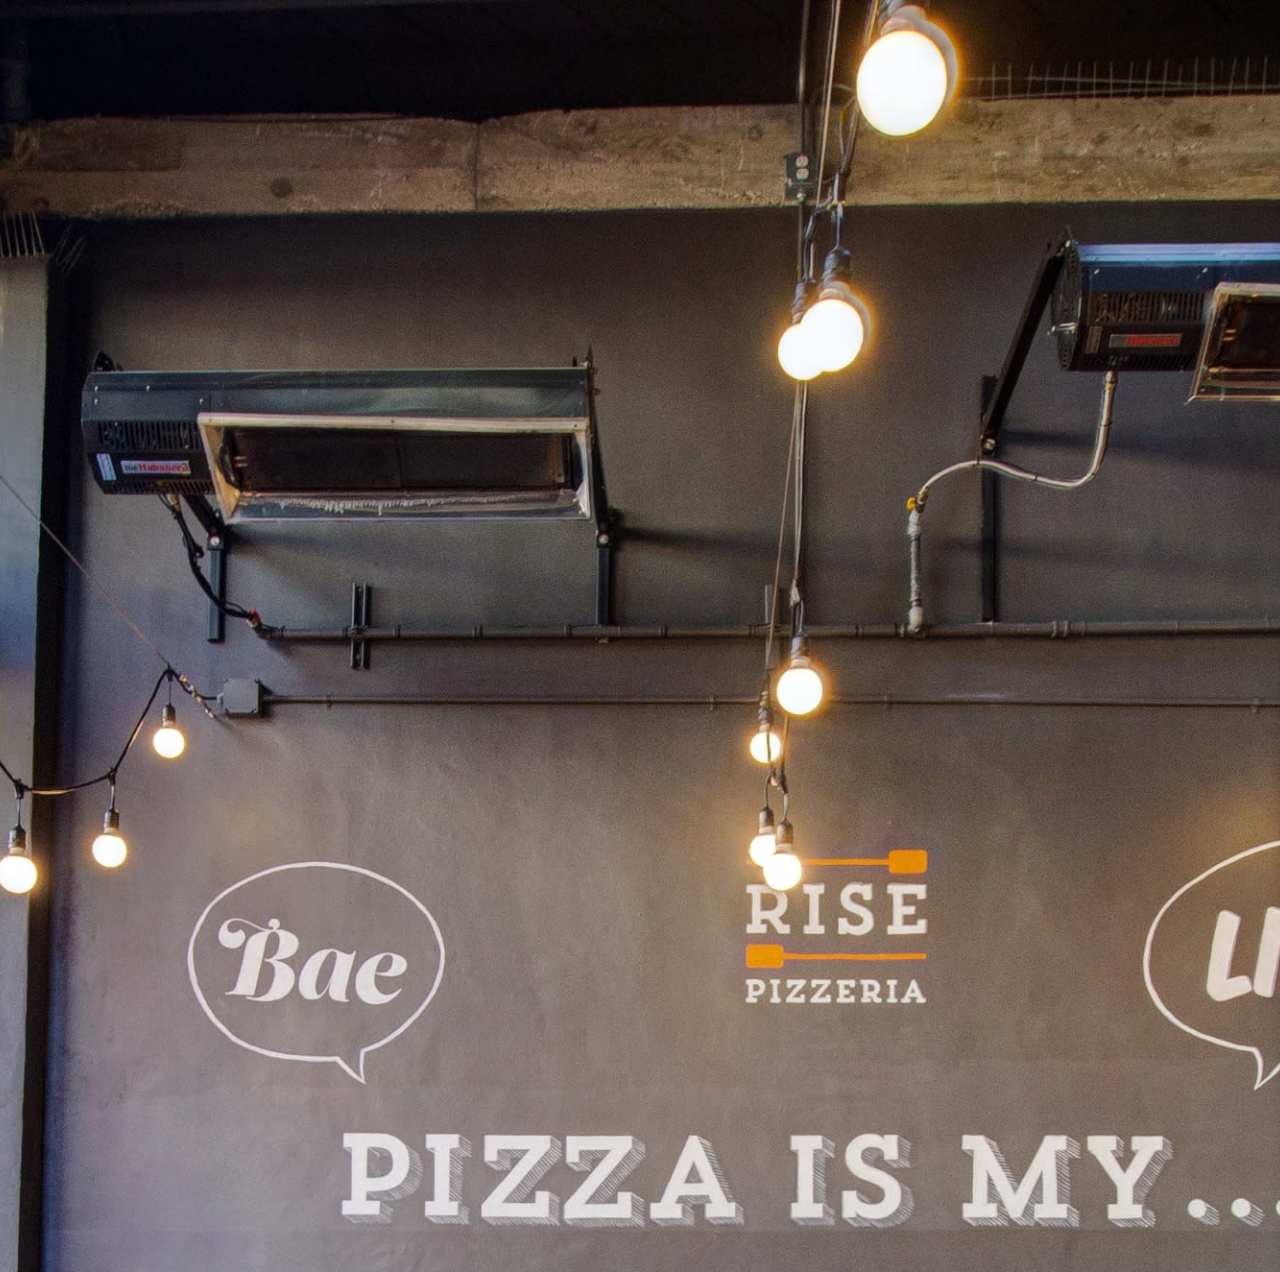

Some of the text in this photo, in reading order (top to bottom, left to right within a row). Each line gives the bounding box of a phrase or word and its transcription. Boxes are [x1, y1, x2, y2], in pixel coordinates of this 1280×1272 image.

[745, 882, 927, 936] RISE
[218, 918, 408, 1005] Bae
[745, 979, 927, 1003] PIZZERIA
[341, 1132, 745, 1227] PIZZA
[790, 1132, 915, 1228] IS
